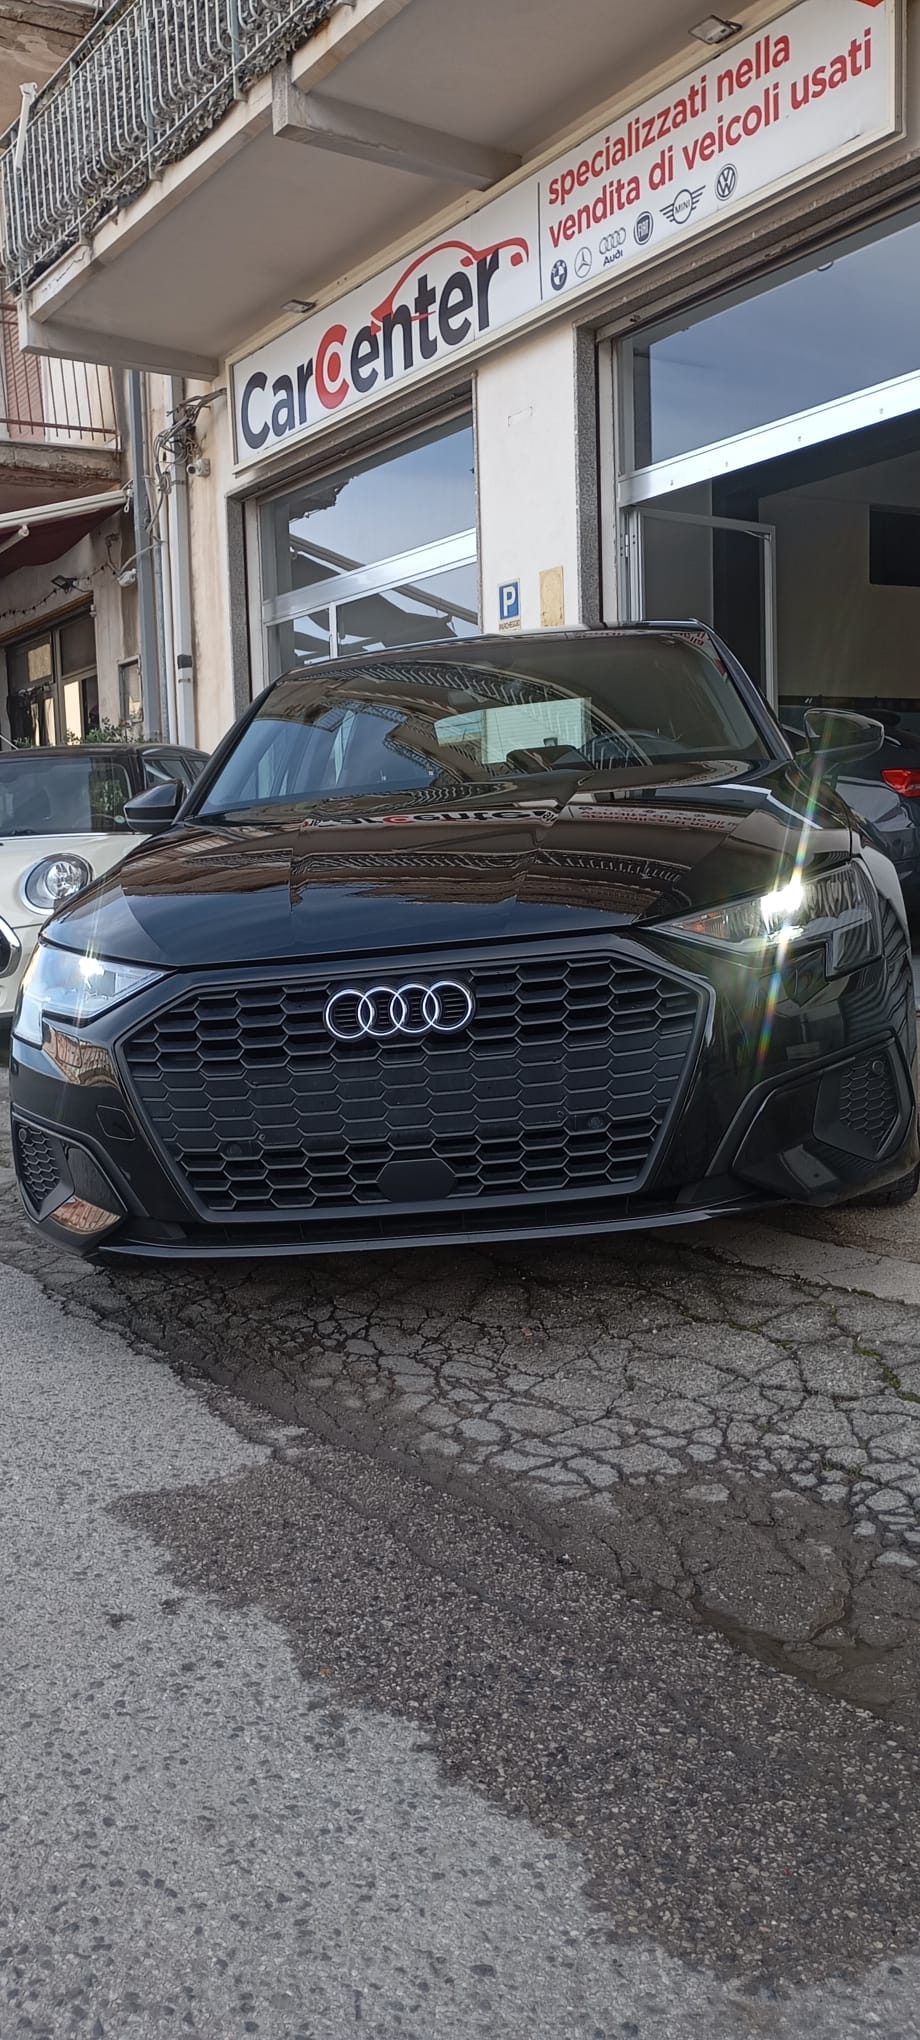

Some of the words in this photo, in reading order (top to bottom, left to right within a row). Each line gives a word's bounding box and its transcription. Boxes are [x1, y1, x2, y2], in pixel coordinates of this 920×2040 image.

[548, 75, 707, 205] specializzati
[716, 34, 790, 102] nella
[549, 176, 640, 249] vendita
[649, 145, 674, 190] di
[682, 82, 780, 171] veicoli
[790, 27, 872, 110] usati
[674, 199, 691, 214] MINI
[603, 250, 624, 267] Audi
[241, 248, 500, 450] CarCenter
[503, 586, 516, 617] P
